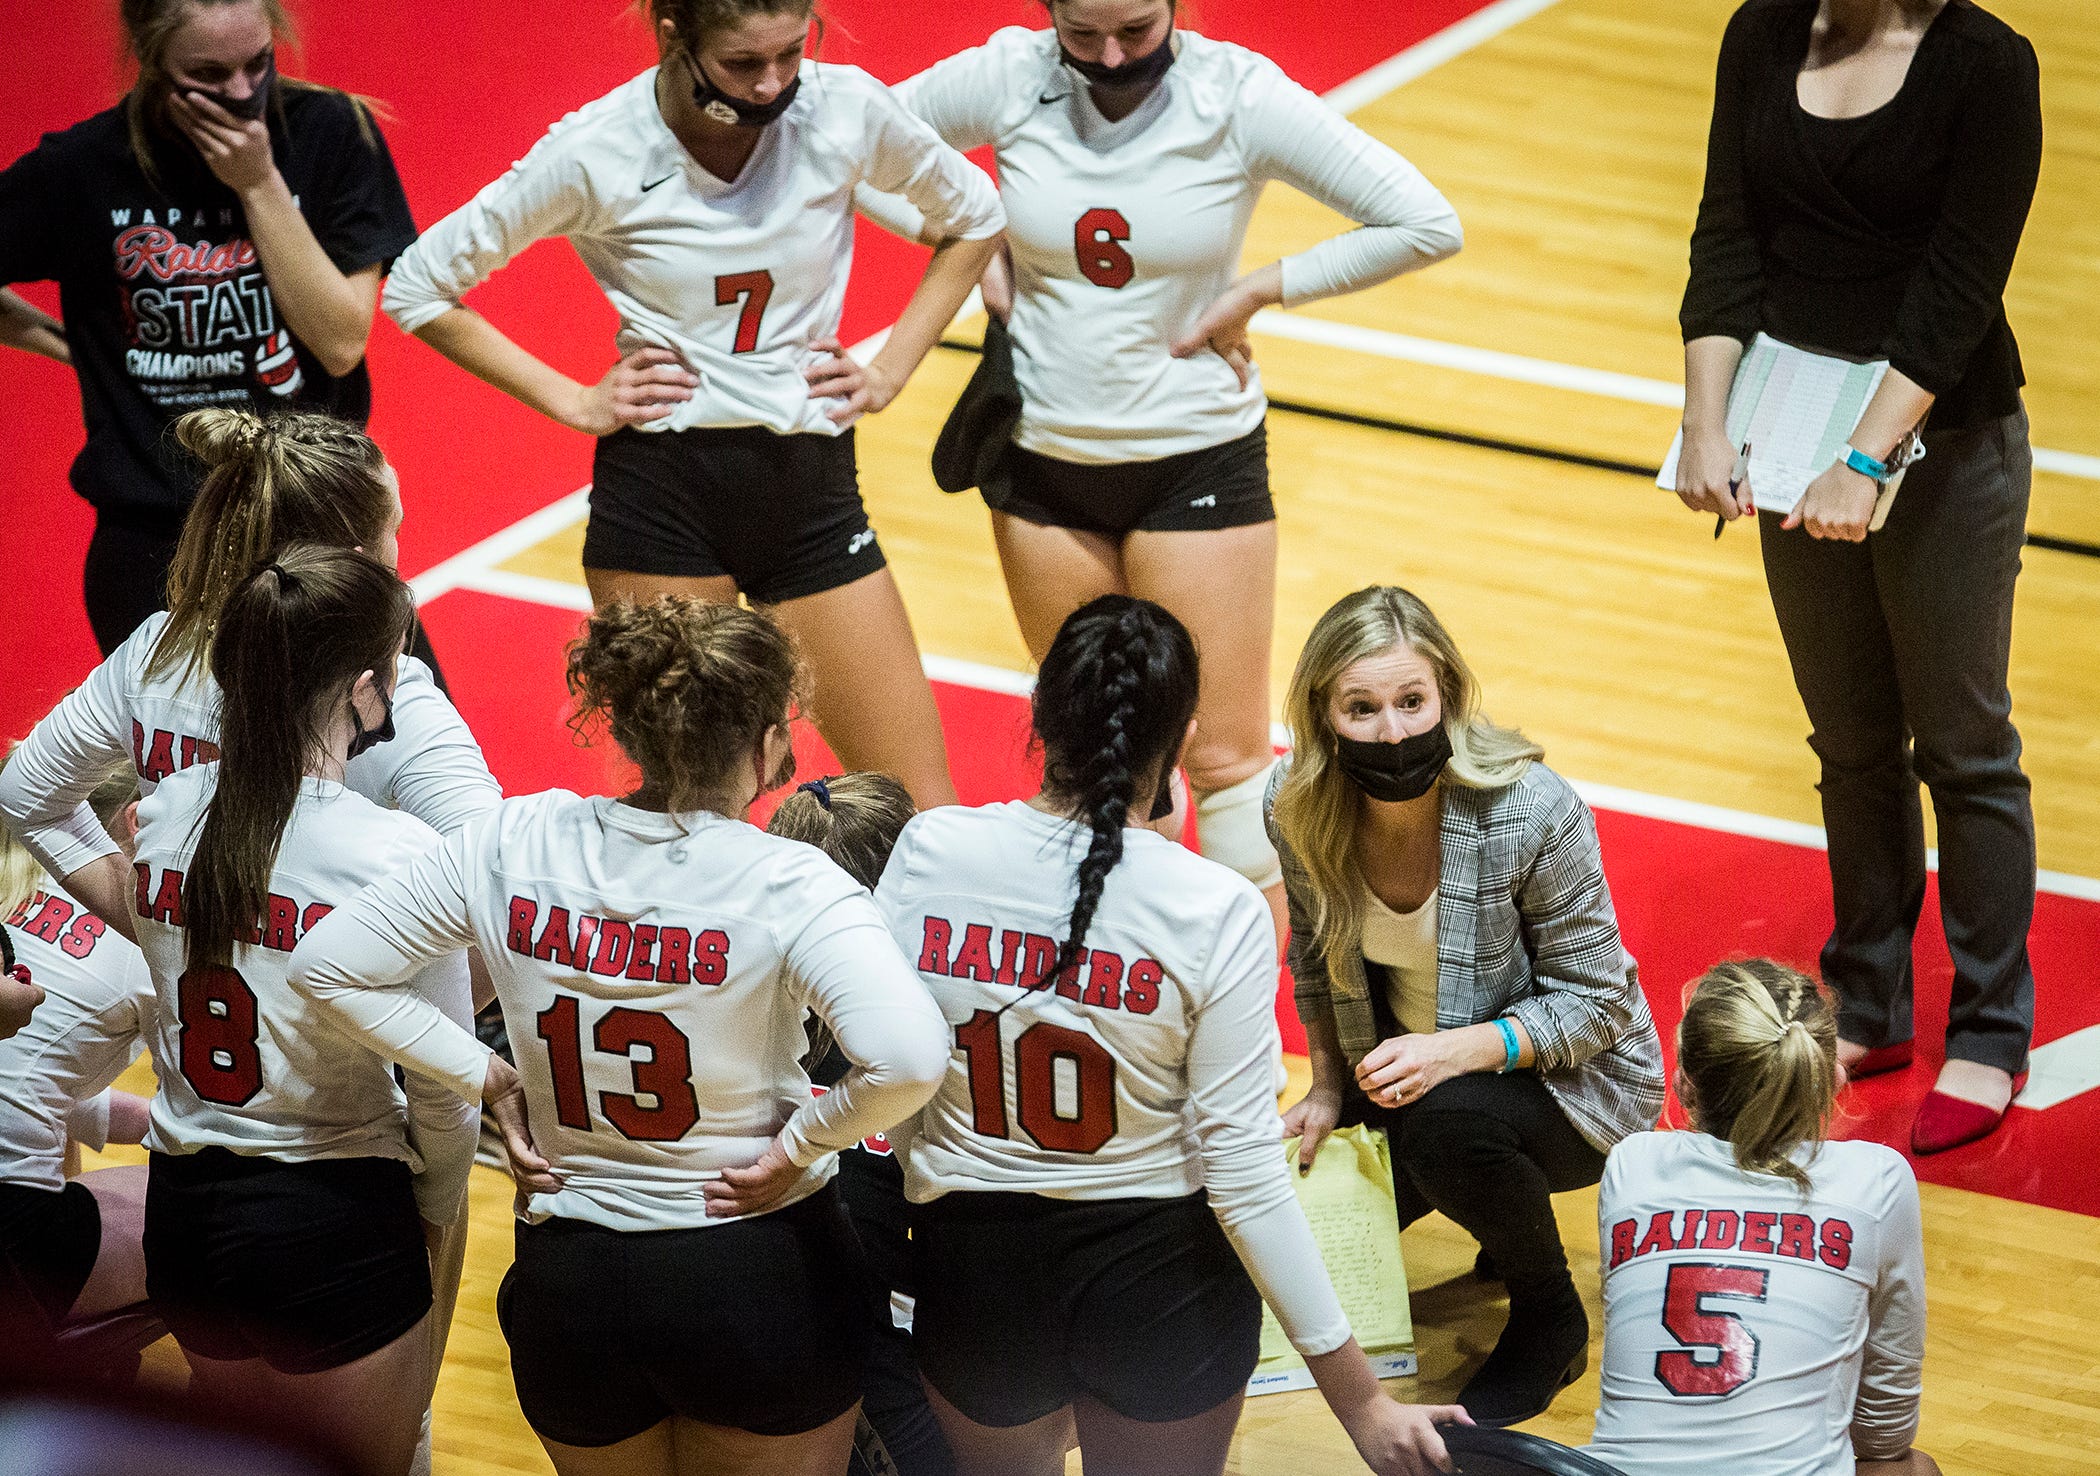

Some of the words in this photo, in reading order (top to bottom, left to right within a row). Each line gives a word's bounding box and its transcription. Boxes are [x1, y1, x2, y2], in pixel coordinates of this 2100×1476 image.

[113, 224, 258, 284] Raide
[1074, 207, 1135, 290] 6
[131, 273, 275, 348] STAT
[714, 270, 775, 354] 7
[125, 348, 246, 380] CHAMPIONS
[507, 895, 731, 986] RAIDERS
[918, 915, 1163, 1016] RAIDERS
[178, 965, 264, 1108] 8
[537, 994, 701, 1142] 13
[954, 1008, 1119, 1155] 10
[1609, 1209, 1854, 1271] RAIDERS
[1654, 1262, 1770, 1397] 5
